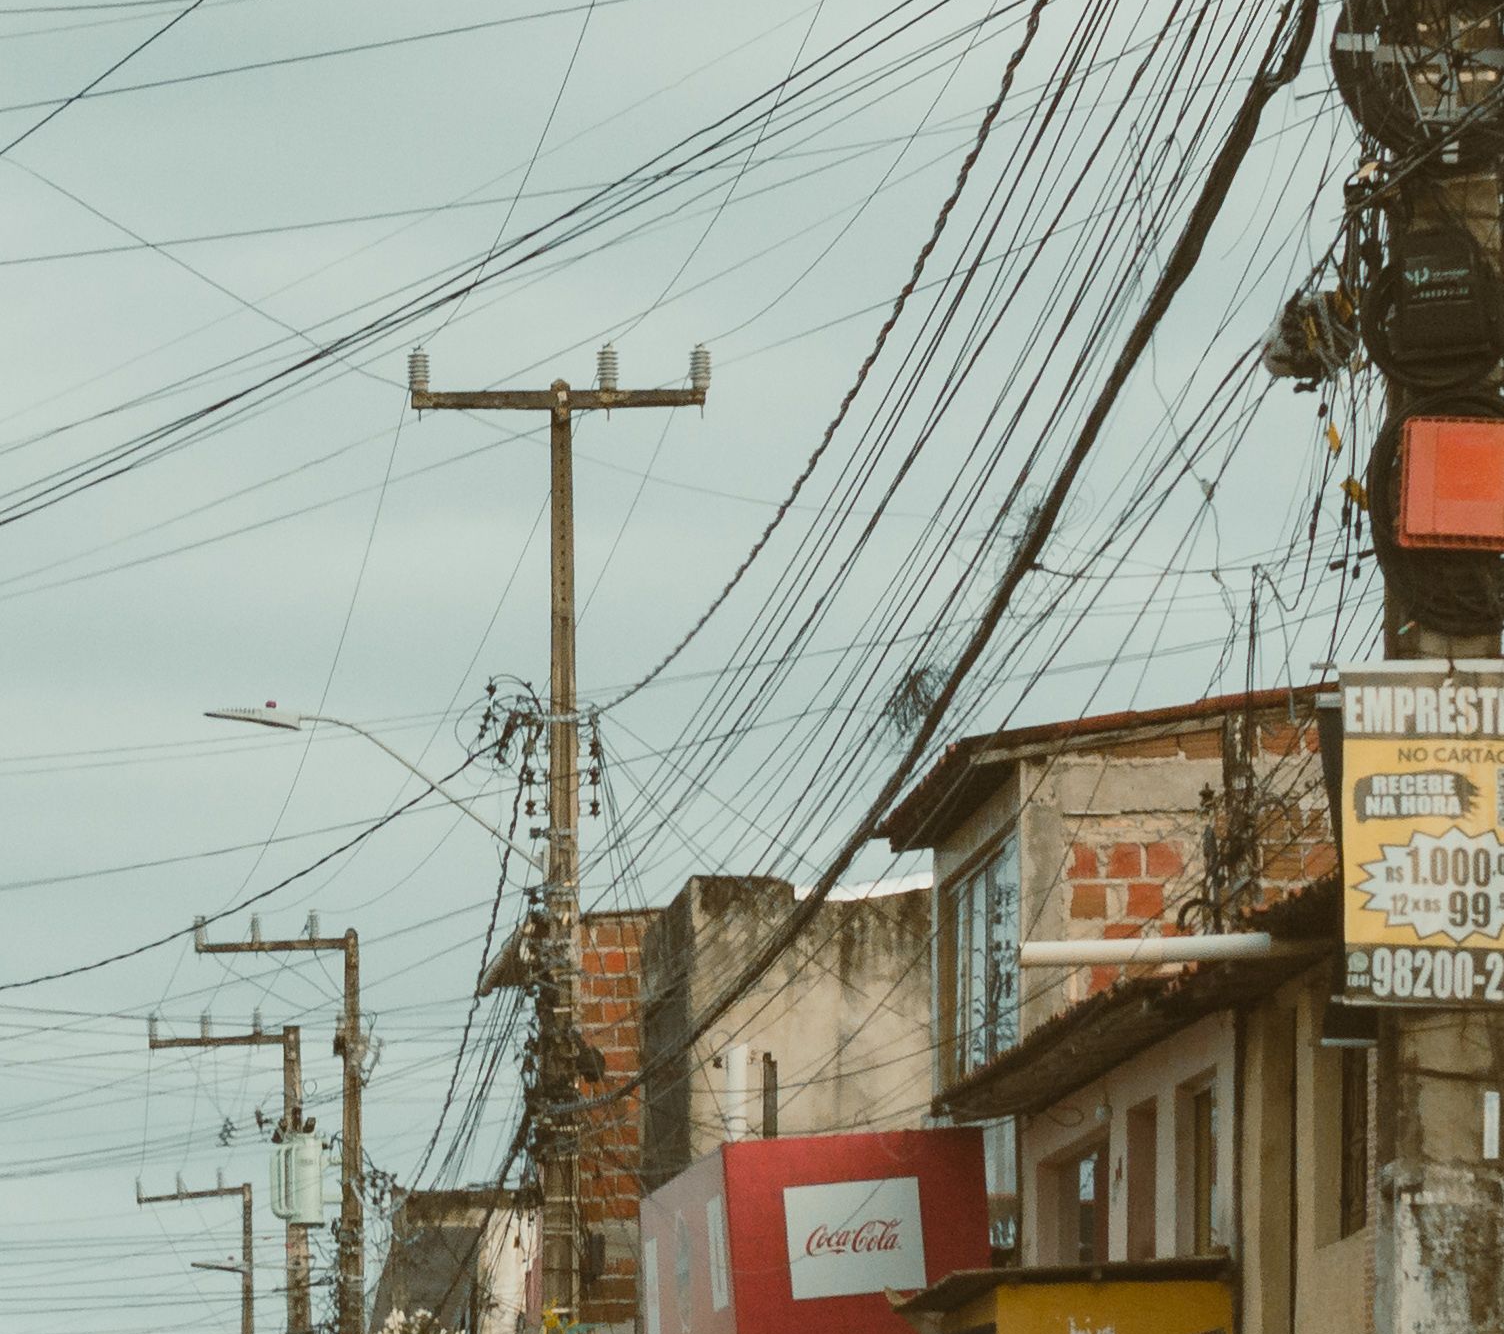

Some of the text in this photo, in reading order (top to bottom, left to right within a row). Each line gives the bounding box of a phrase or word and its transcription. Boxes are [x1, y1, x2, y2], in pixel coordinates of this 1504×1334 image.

[1397, 748, 1429, 763] NO
[1371, 774, 1457, 796] RECEBE
[1365, 795, 1462, 816] NA HORA
[805, 1219, 903, 1257] Coca-Cola
